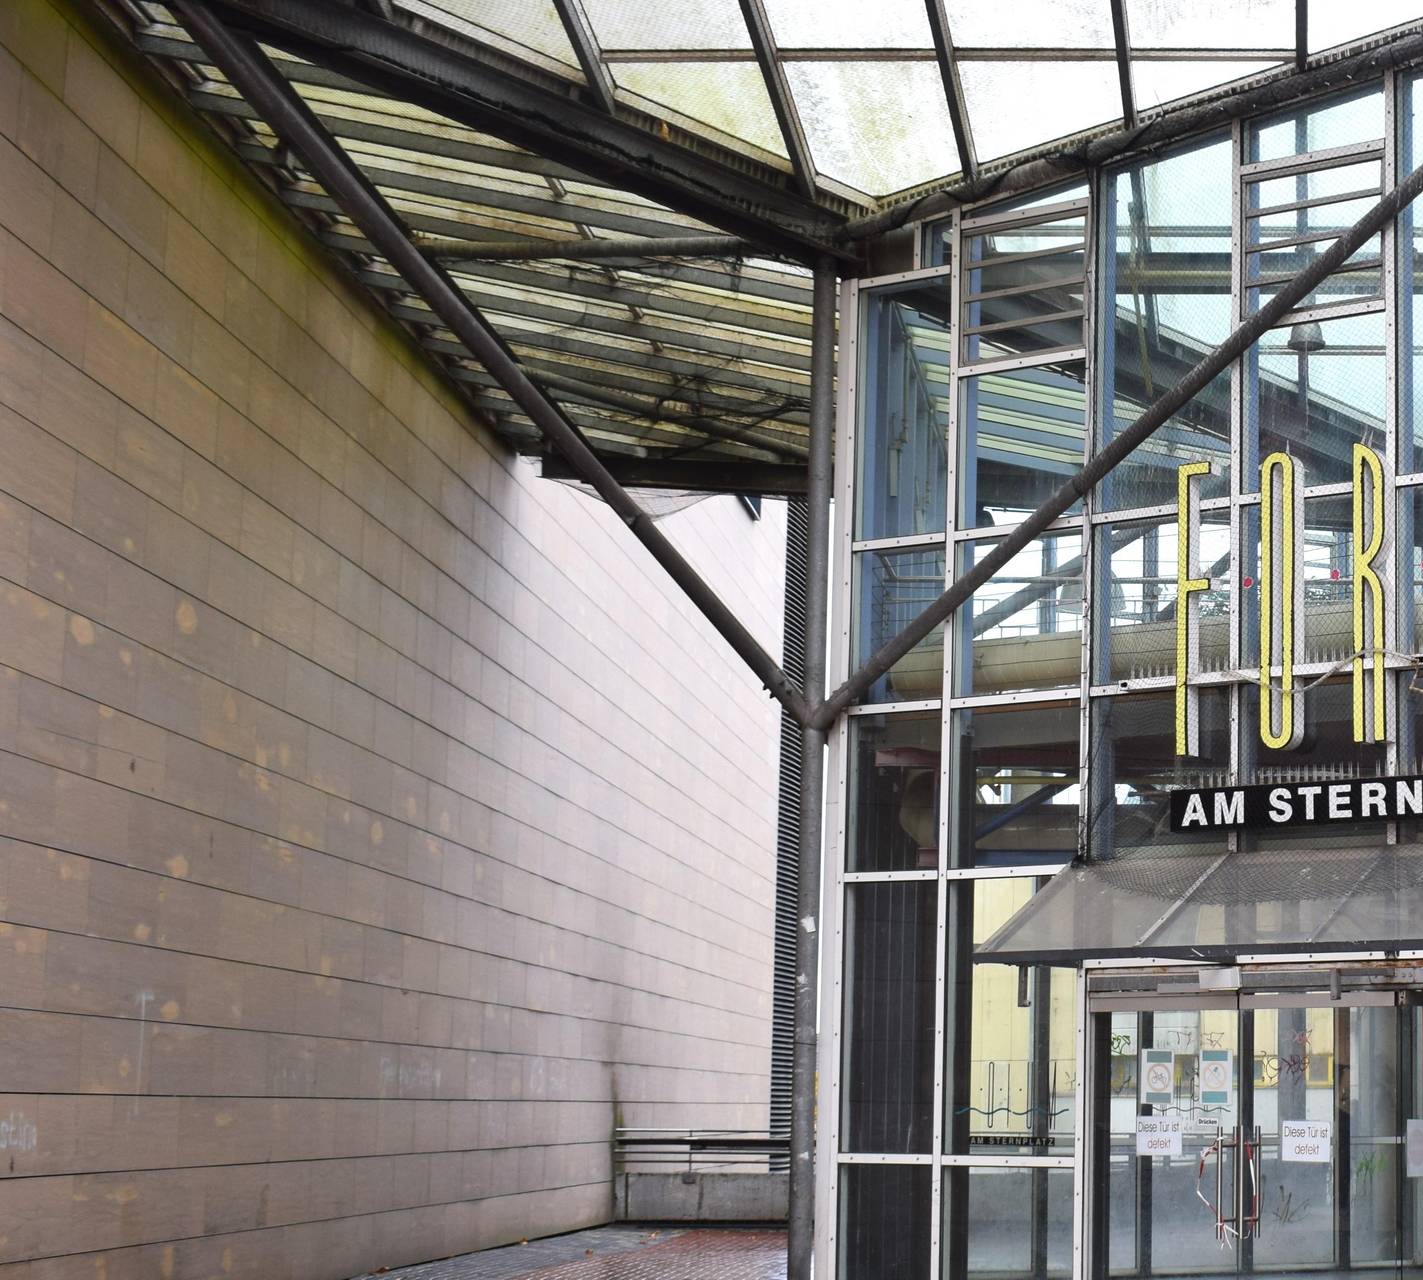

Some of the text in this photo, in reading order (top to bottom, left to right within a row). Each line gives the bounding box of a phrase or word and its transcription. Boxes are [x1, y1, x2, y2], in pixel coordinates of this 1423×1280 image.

[1181, 791, 1245, 827] AM
[1138, 1121, 1157, 1132] Diese
[1171, 1121, 1180, 1132] ist
[1284, 1126, 1328, 1137] Diese Tür ist
[970, 1136, 1055, 1146] AM STERNPLATZ
[1147, 1139, 1171, 1149] defekt
[1295, 1143, 1320, 1155] defekt
